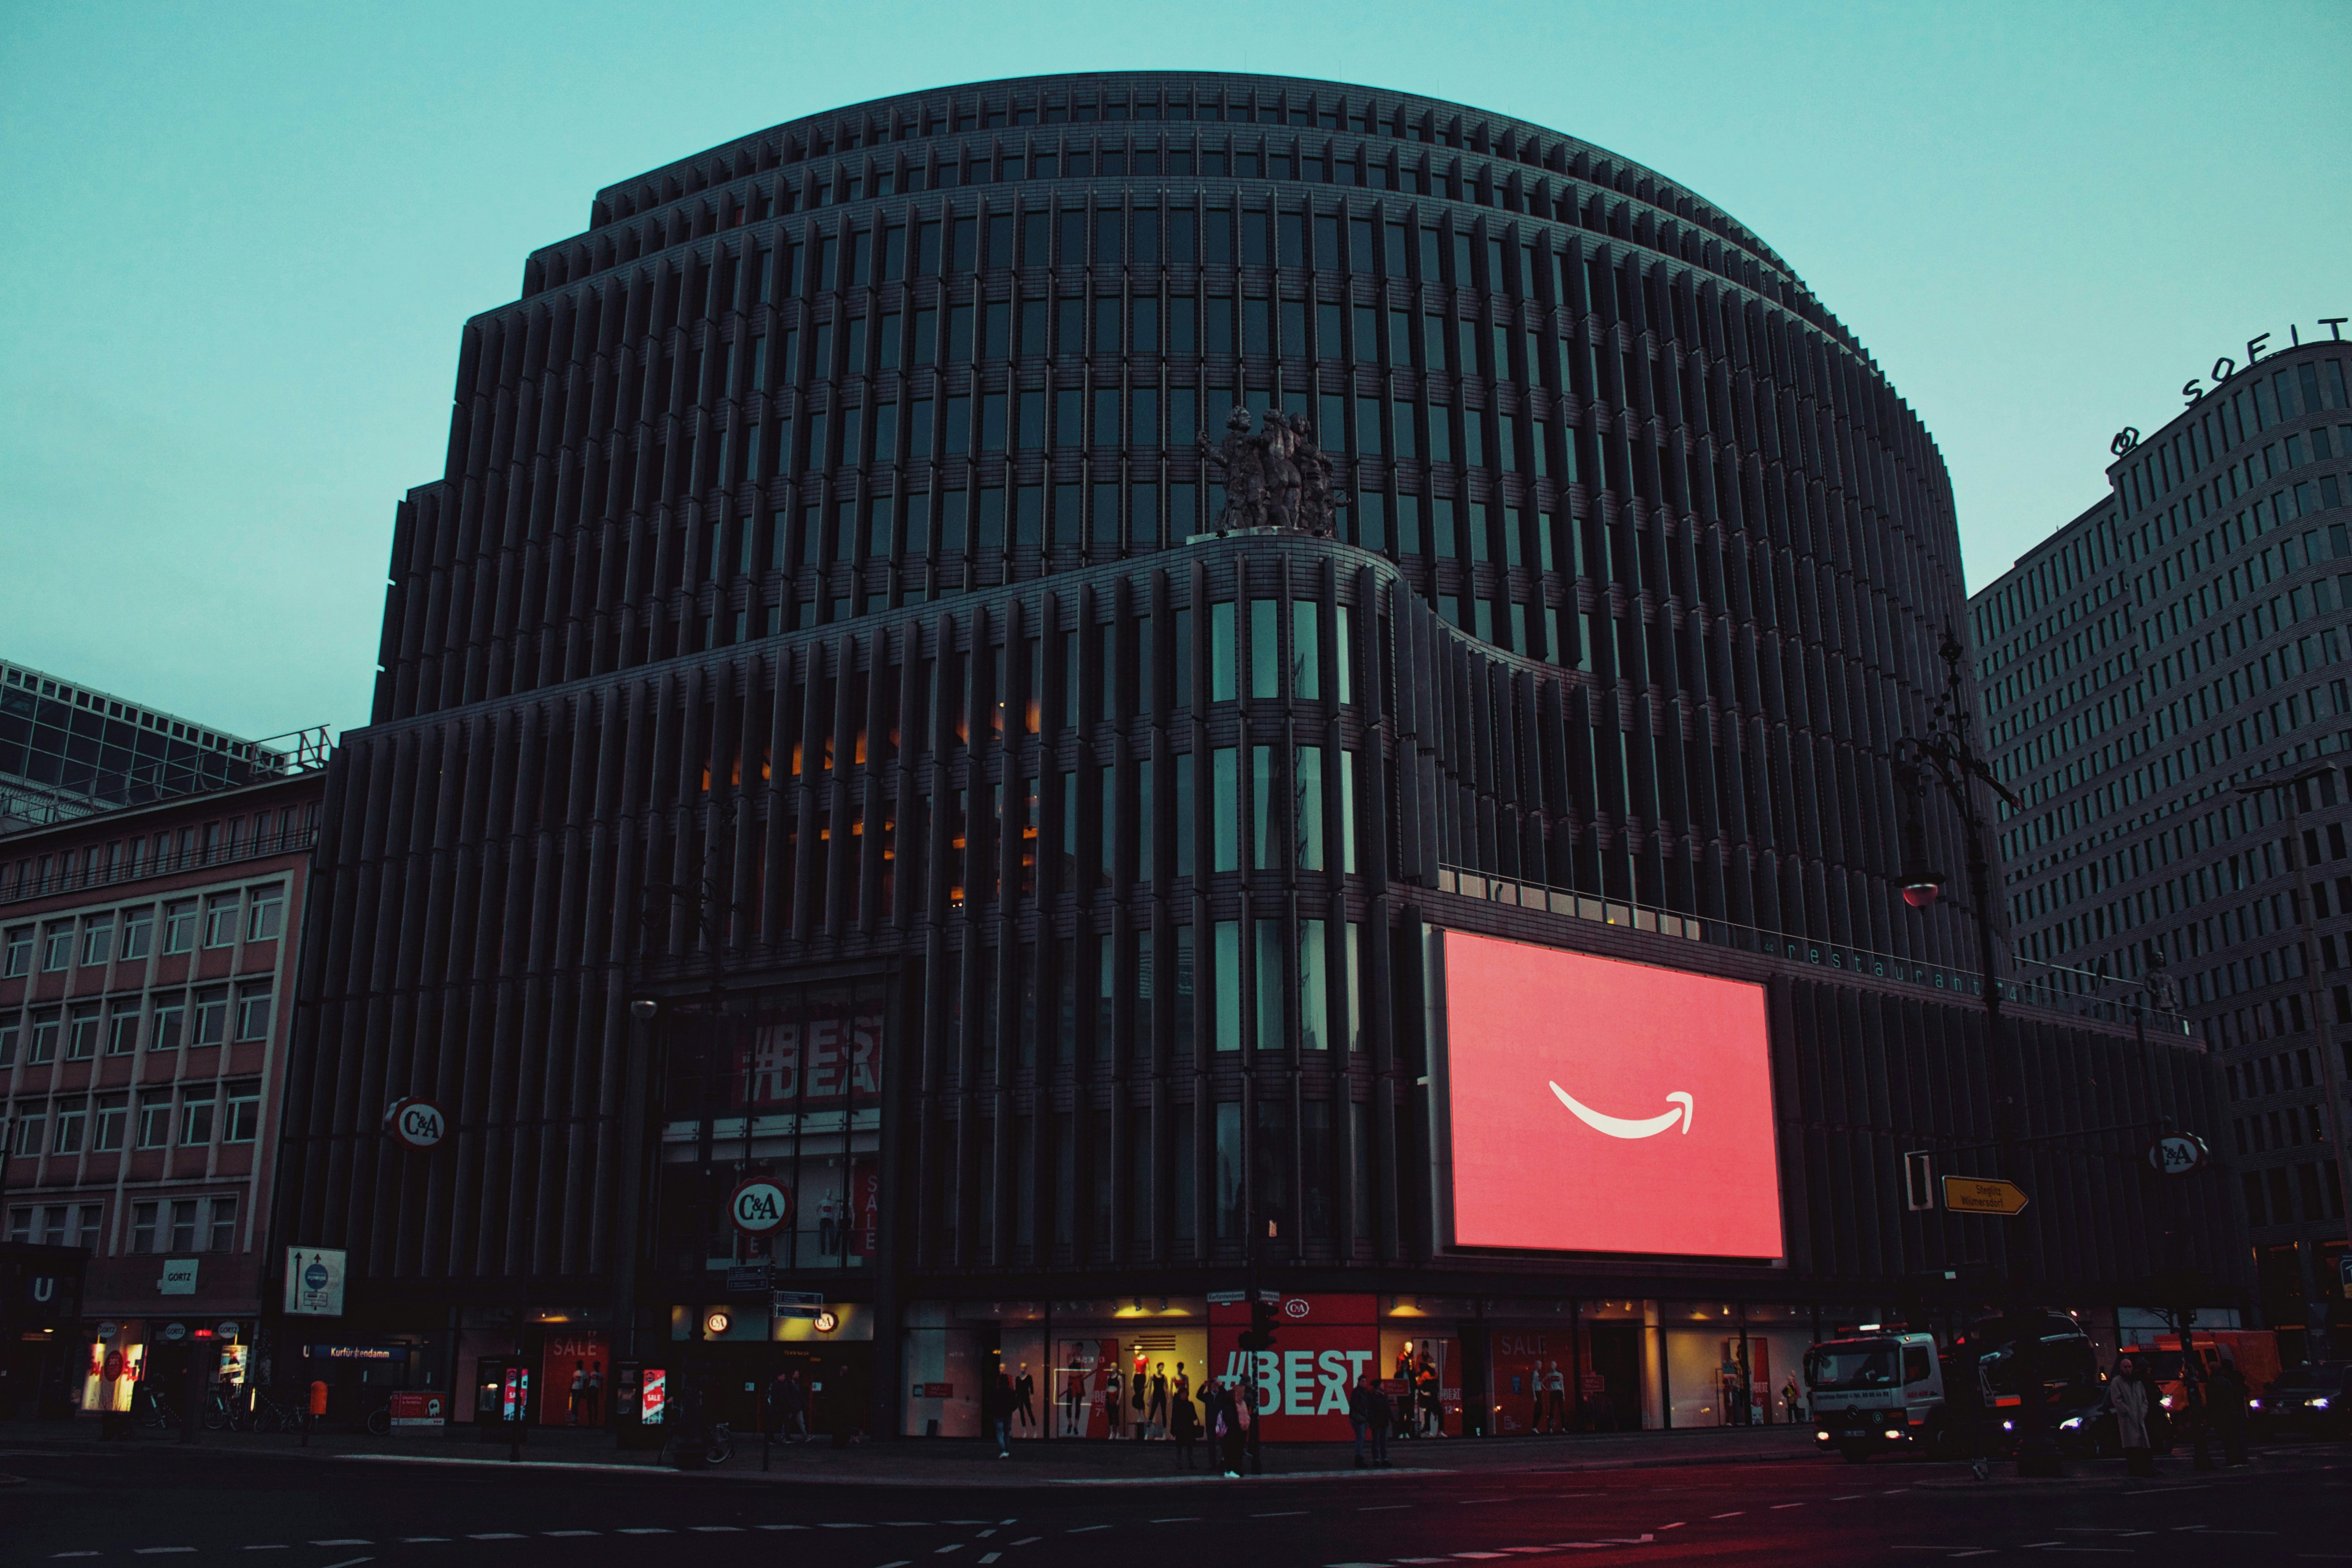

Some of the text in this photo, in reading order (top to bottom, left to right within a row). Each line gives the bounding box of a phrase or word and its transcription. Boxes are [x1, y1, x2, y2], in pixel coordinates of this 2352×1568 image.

[2182, 317, 2348, 408] SOFIT
[1788, 944, 1980, 996] restaurant
[405, 1111, 440, 1138] C&A
[2162, 1144, 2194, 1166] &A
[1960, 1195, 2003, 1208] Wilmersdorf
[1976, 1185, 2002, 1197] Steglitz
[739, 1193, 779, 1220] C&A
[865, 1175, 877, 1250] SALE
[34, 1277, 54, 1302] U
[1289, 1304, 1305, 1313] C&A
[711, 1317, 724, 1328] C&A
[817, 1316, 831, 1328] C&A
[553, 1337, 597, 1356] SALE
[1501, 1336, 1547, 1355] SALE
[1217, 1350, 1372, 1391] #BEST
[1258, 1380, 1350, 1416] DEA
